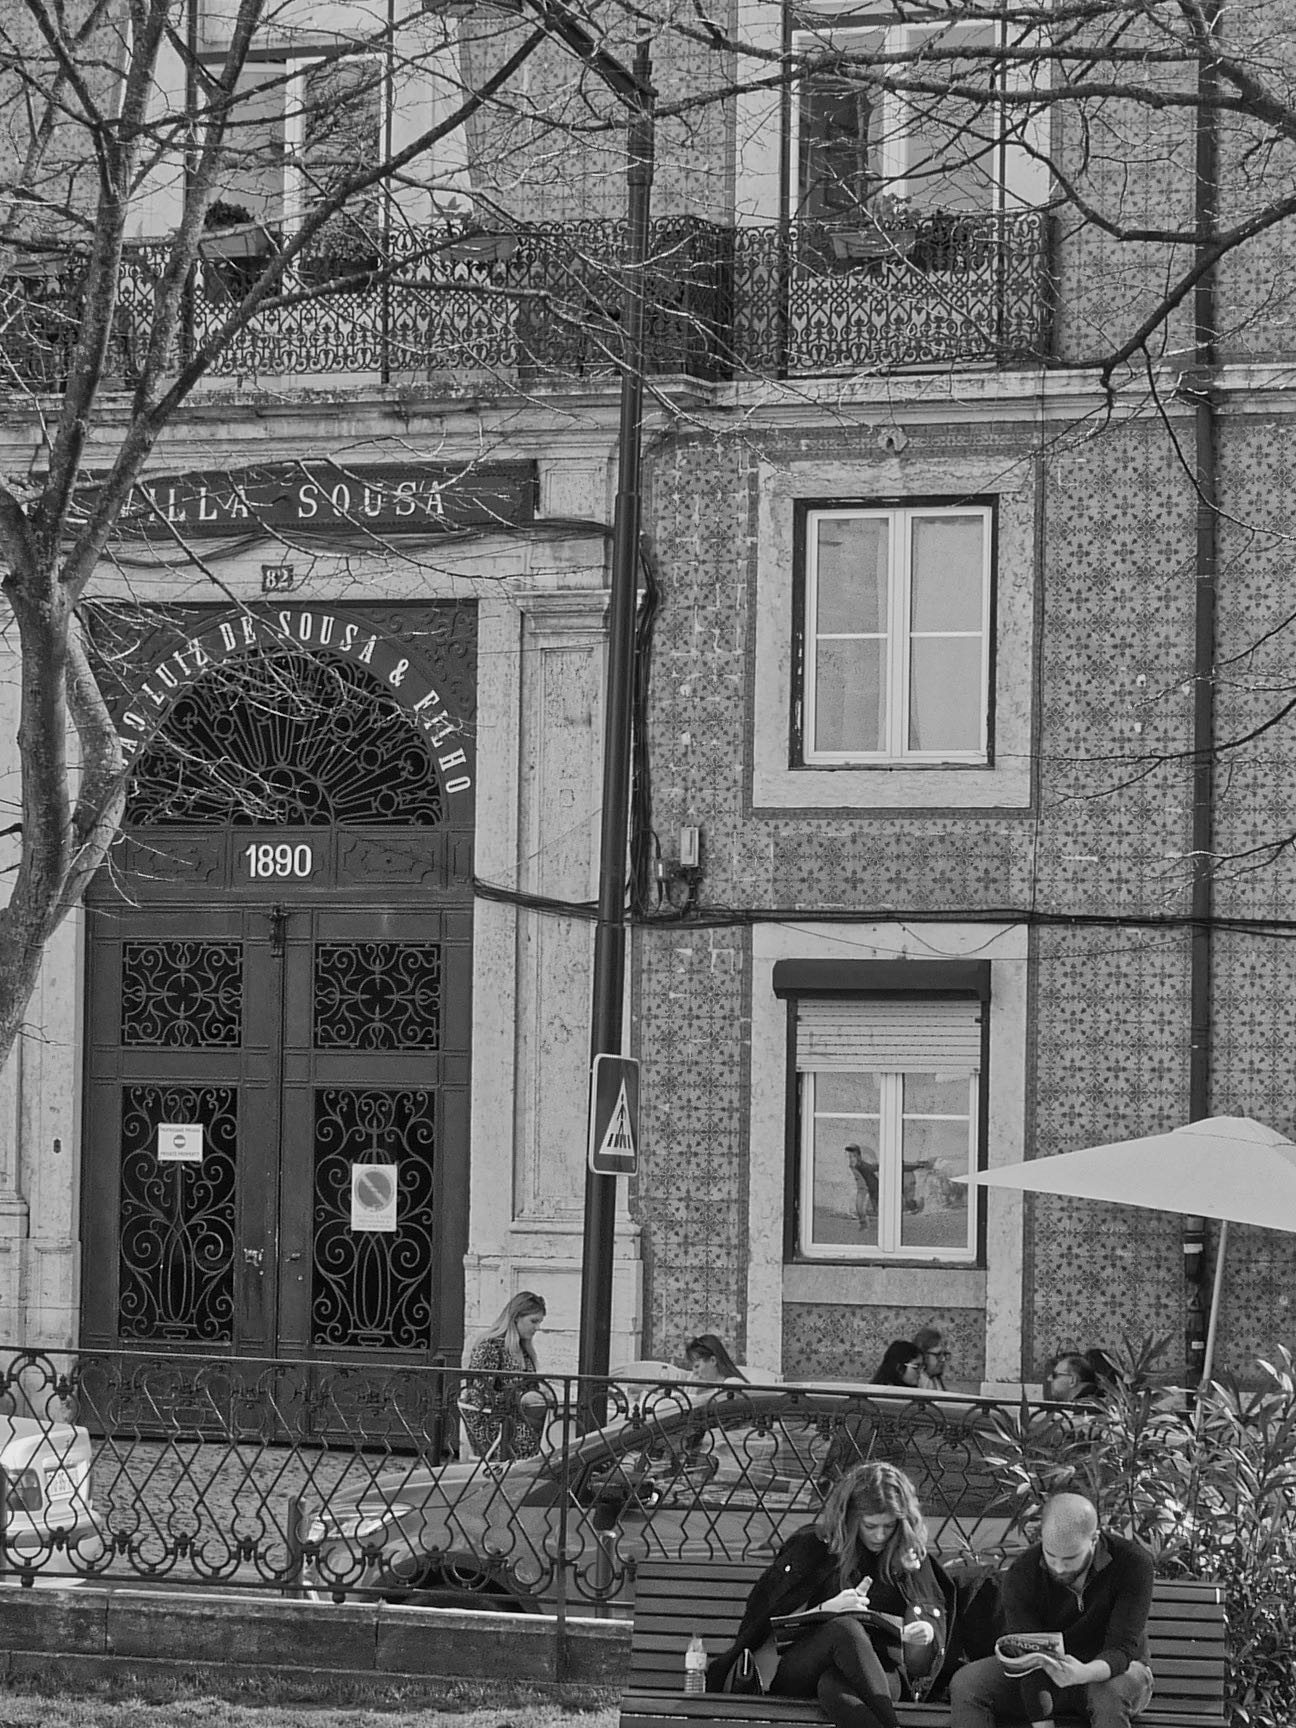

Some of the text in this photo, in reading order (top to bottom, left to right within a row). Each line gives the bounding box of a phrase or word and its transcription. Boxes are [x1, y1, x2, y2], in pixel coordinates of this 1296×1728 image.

[121, 481, 445, 522] ILLA SOUSA
[264, 568, 288, 589] 82
[219, 616, 256, 651] DE
[278, 610, 378, 664] SOUSA
[389, 658, 410, 687] &
[413, 689, 471, 794] FILHO
[245, 844, 312, 878] 1890
